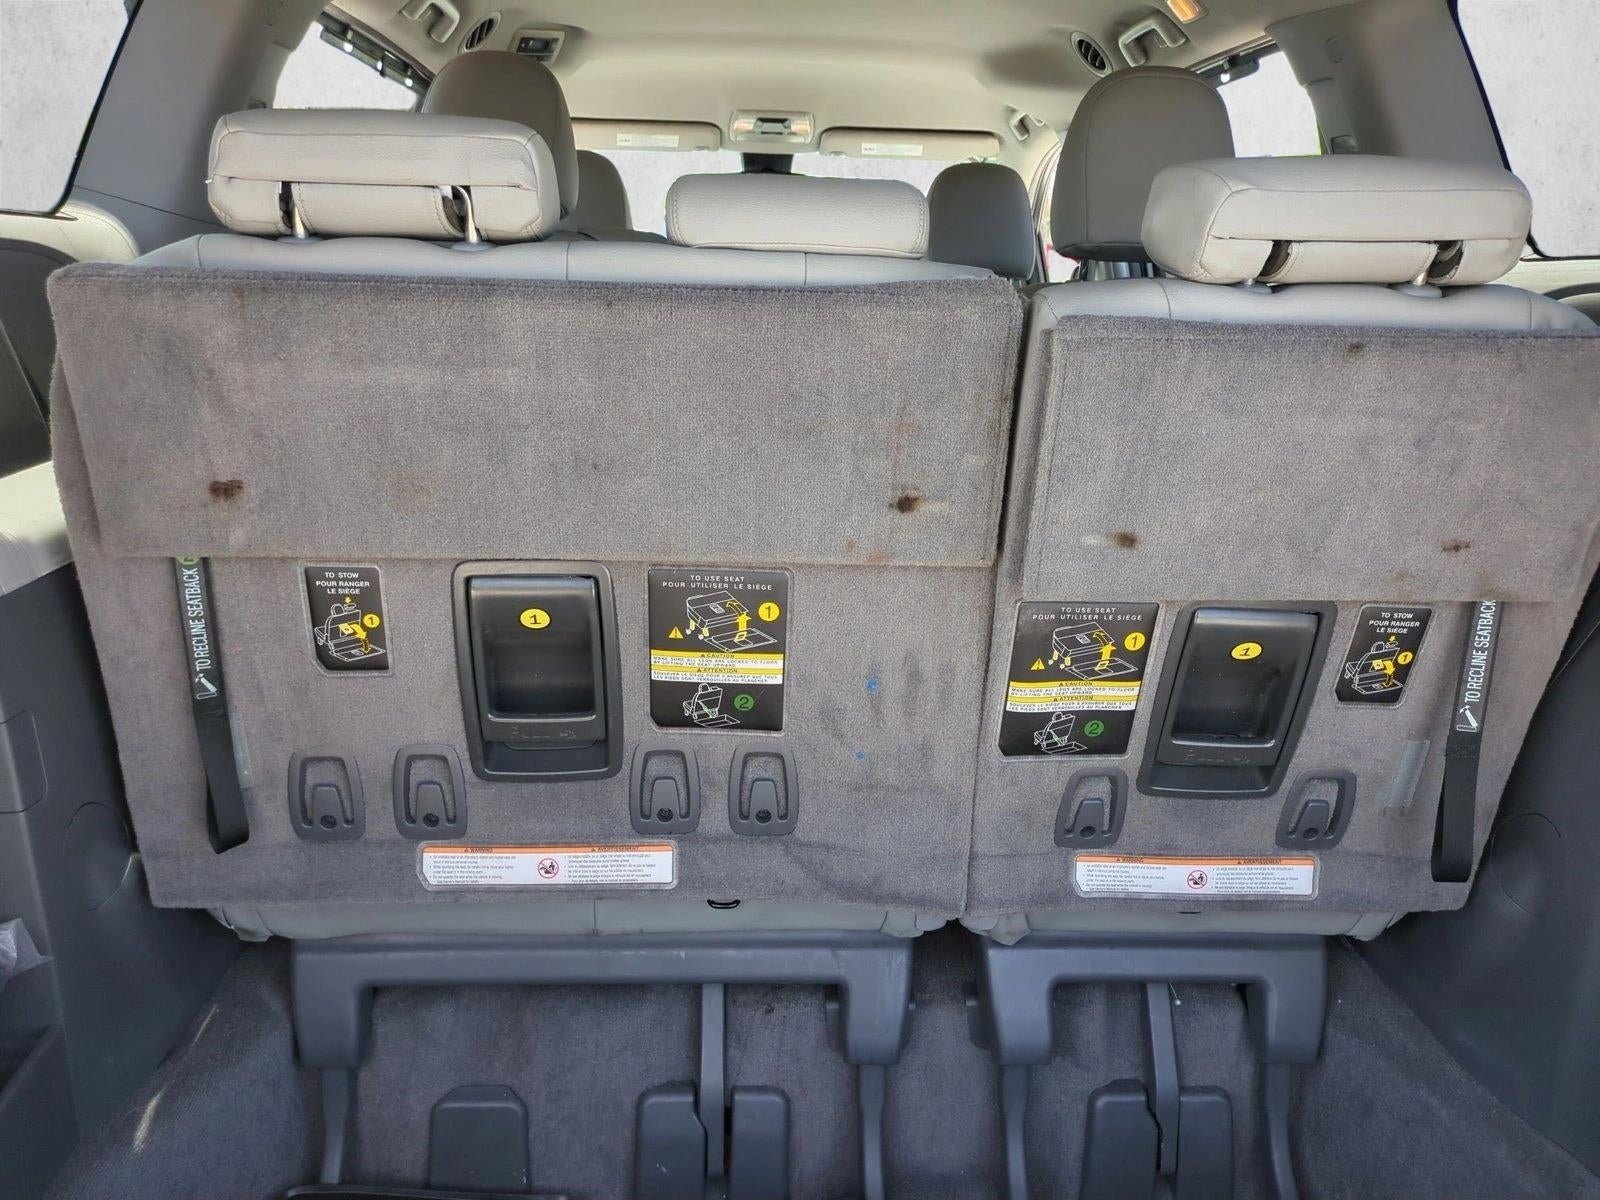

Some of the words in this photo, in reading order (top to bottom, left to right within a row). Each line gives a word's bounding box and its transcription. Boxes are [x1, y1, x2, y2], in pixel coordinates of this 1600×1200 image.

[182, 567, 204, 616] SEATBACK
[189, 618, 210, 658] RECLINE
[1474, 599, 1496, 648] SEATBACK
[196, 660, 211, 672] TO
[1467, 650, 1488, 689] RECLINE
[1464, 691, 1481, 702] TO
